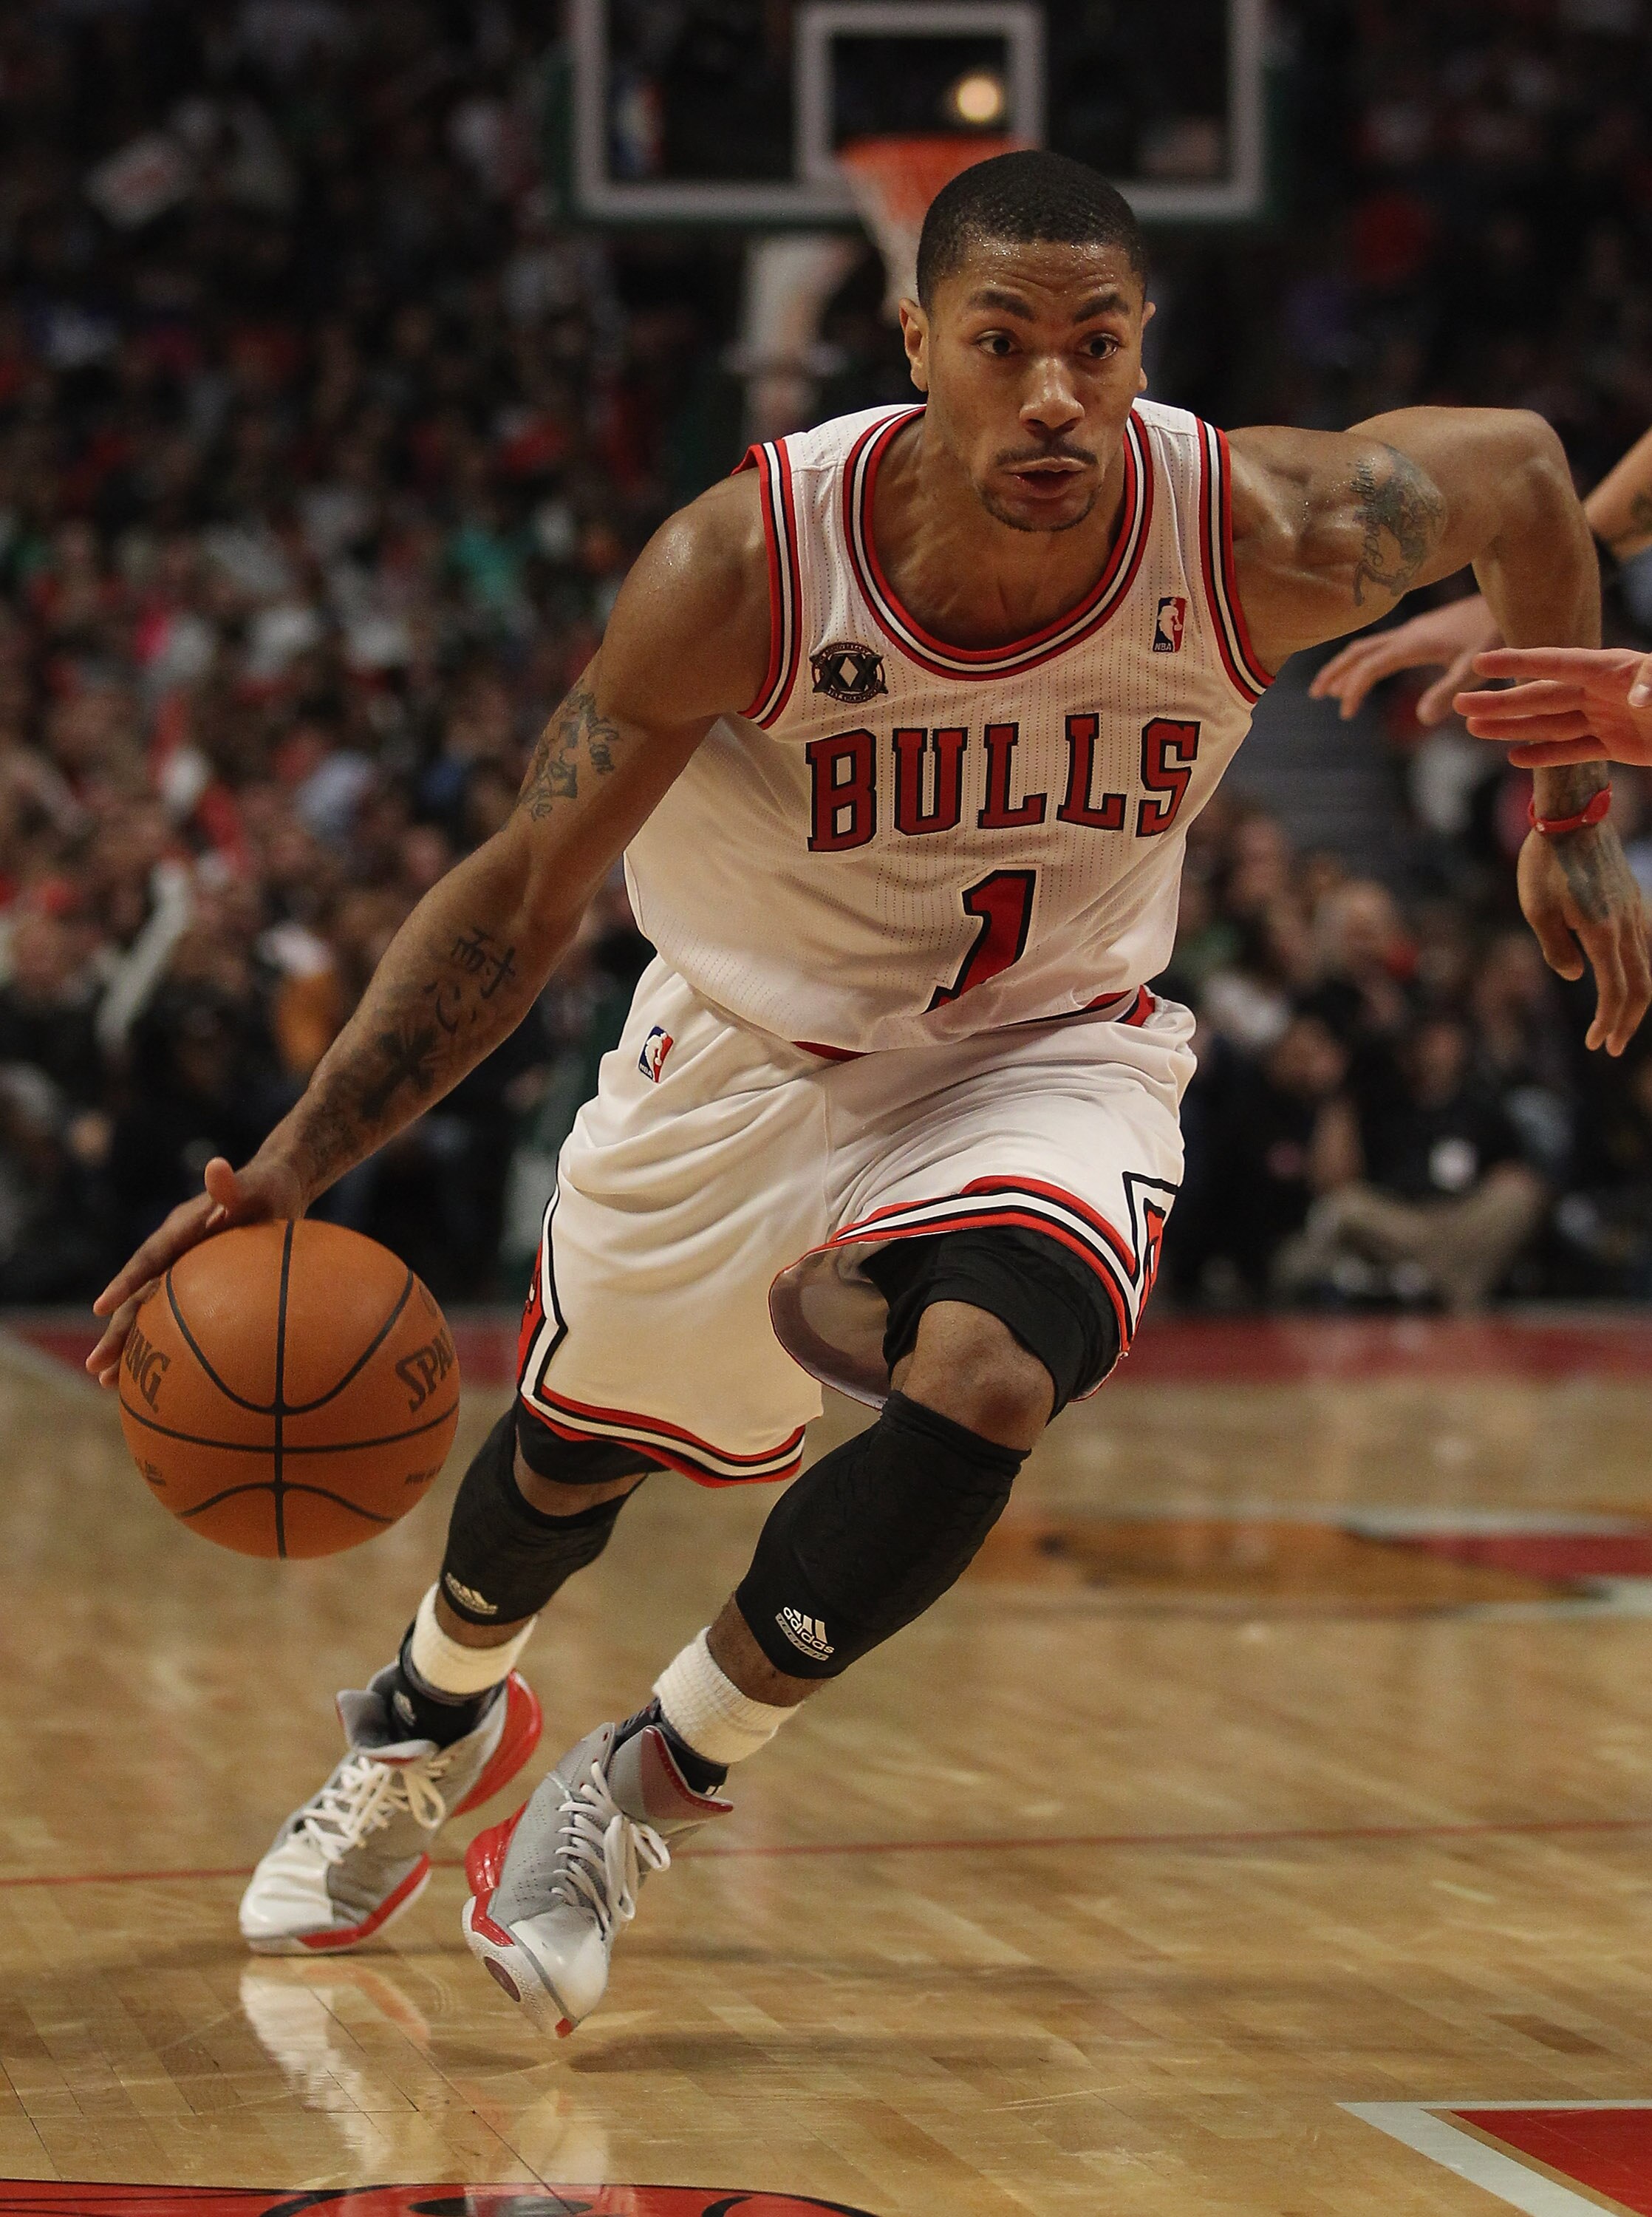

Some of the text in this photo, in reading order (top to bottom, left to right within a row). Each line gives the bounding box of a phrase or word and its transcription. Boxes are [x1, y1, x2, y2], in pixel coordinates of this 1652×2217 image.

[1154, 642, 1172, 651] NBA
[806, 713, 1201, 852] BULLS
[921, 869, 1037, 1015] 1
[783, 1607, 835, 1654] adidas
